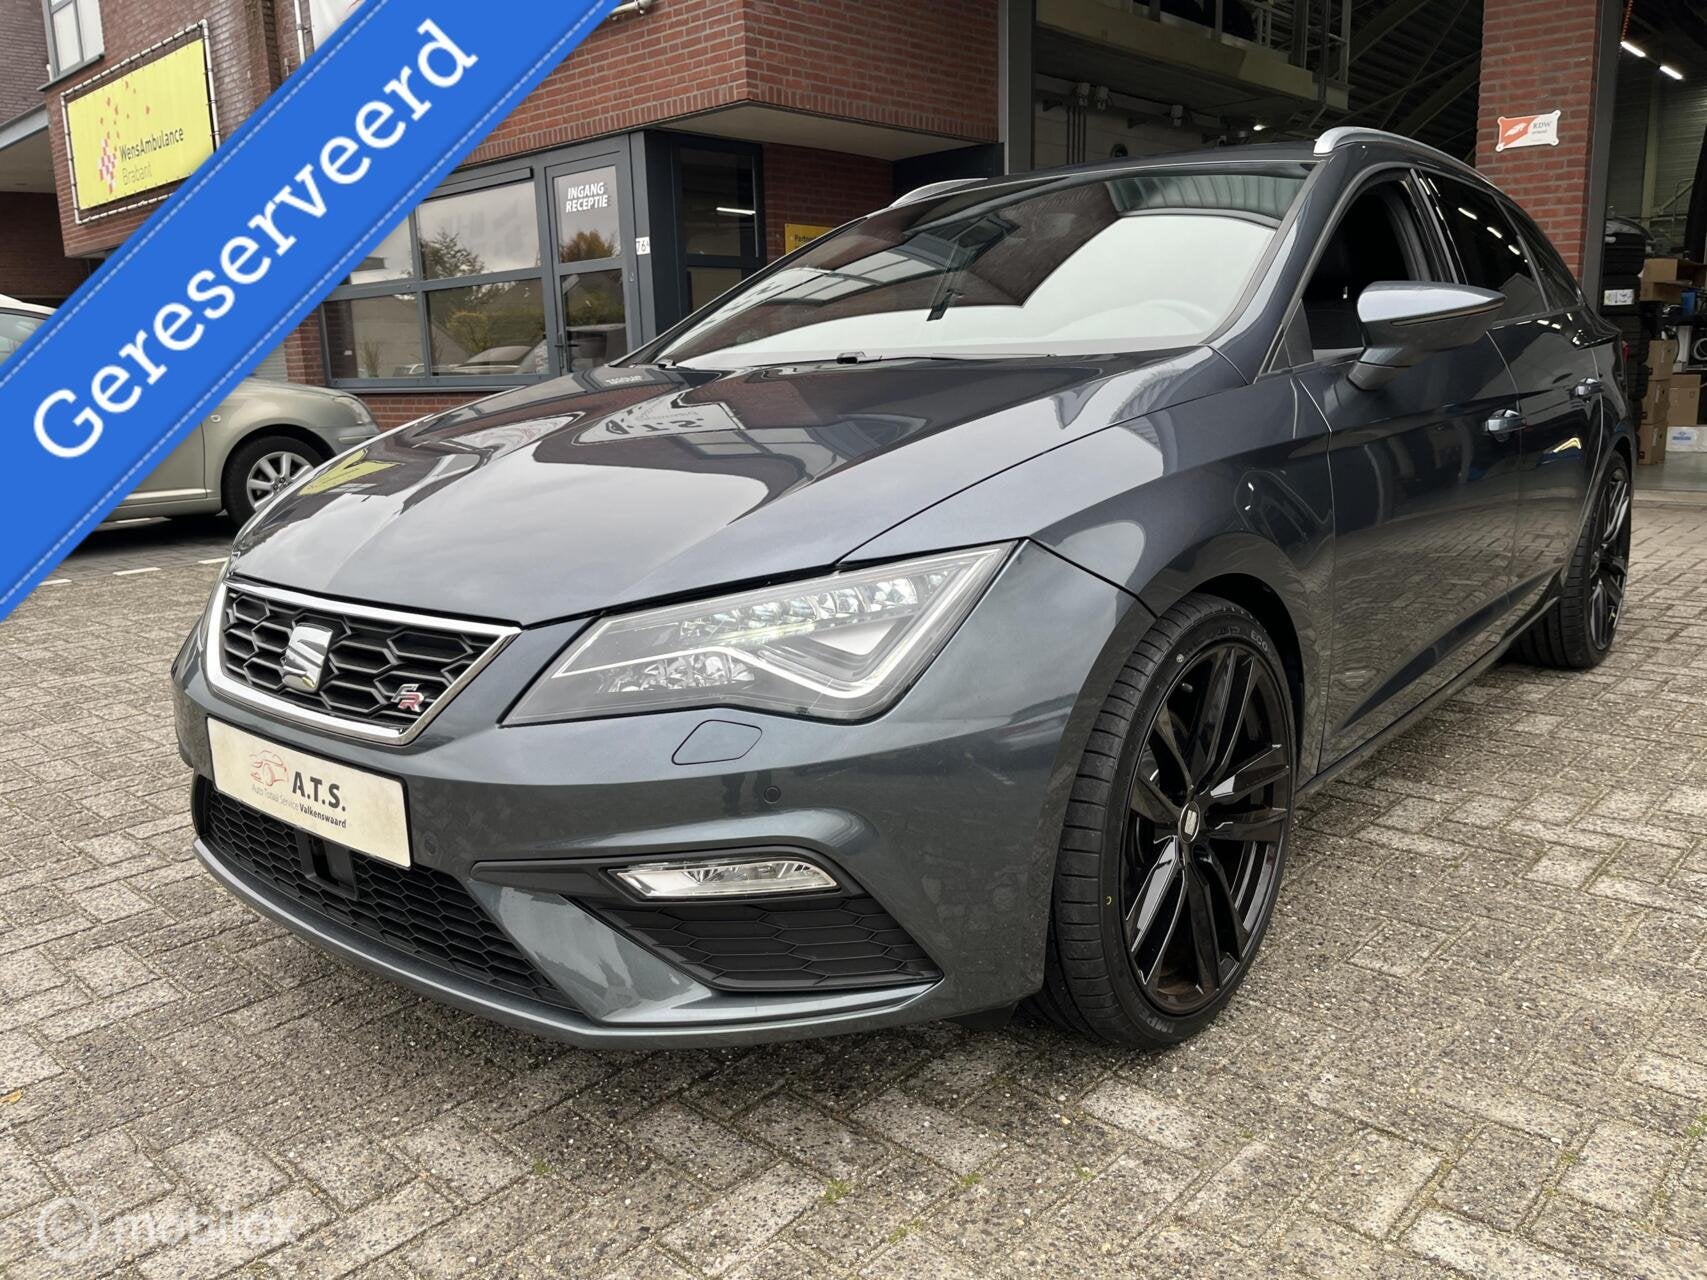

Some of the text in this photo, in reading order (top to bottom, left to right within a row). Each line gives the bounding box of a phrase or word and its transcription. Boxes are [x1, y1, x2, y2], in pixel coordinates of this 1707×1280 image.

[119, 127, 184, 161] WensAmbulance
[121, 162, 152, 186] Brabant
[567, 181, 604, 200] INGANG
[565, 194, 608, 213] RECEPTIE
[292, 771, 346, 812] A.T.S.
[300, 803, 347, 829] Valkenswaard
